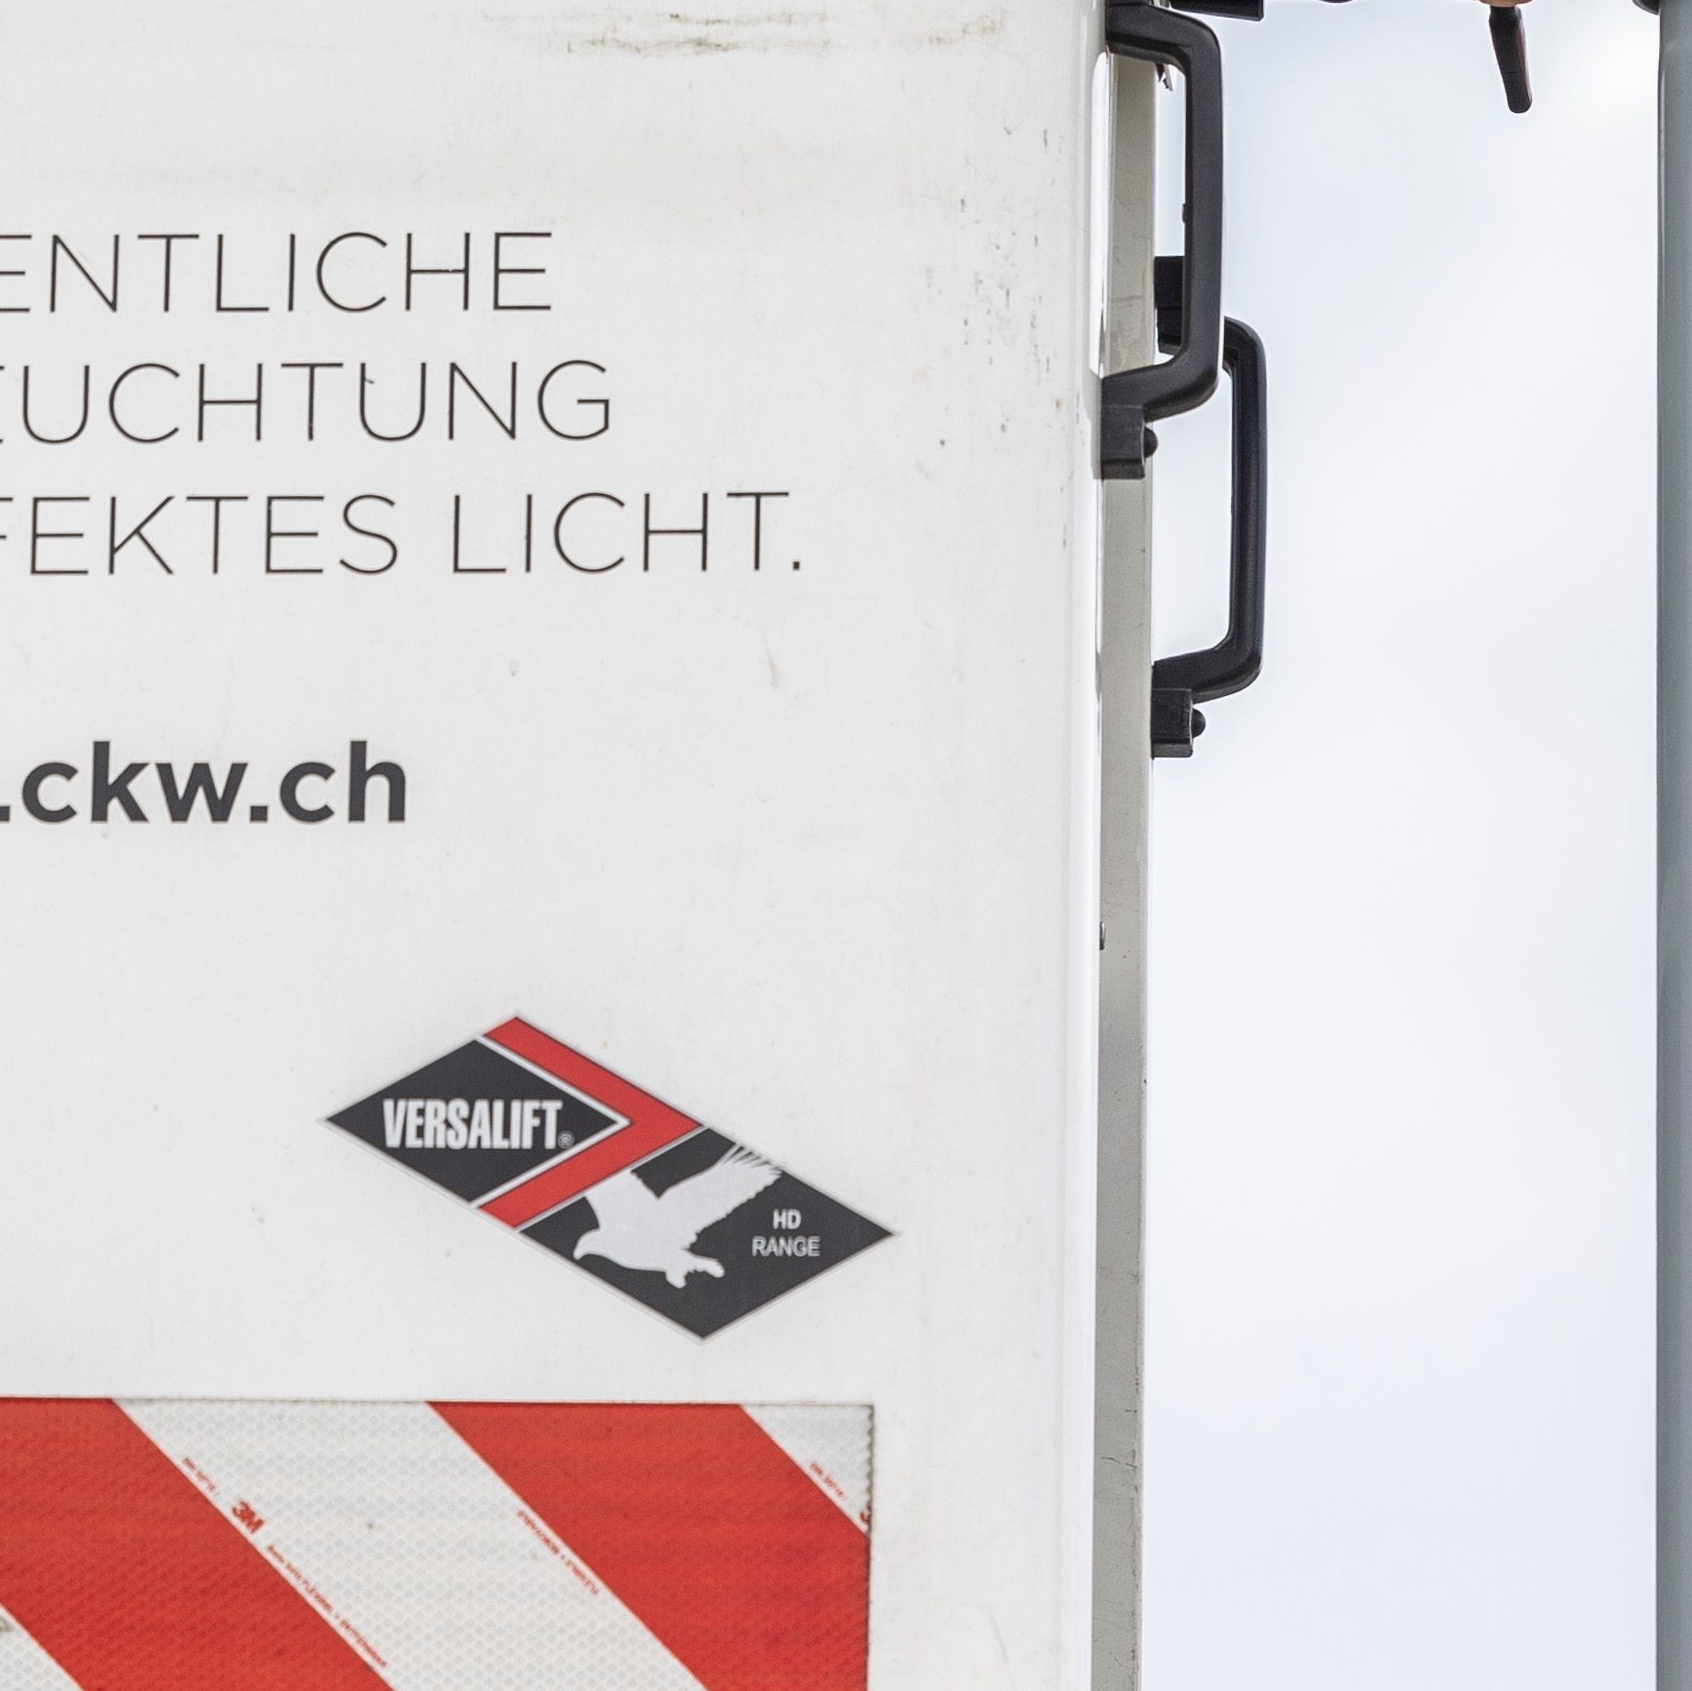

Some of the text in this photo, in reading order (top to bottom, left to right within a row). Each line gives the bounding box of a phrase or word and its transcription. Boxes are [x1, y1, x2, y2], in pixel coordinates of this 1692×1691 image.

[452, 491, 801, 574] LICHT.
[772, 1209, 802, 1230] HD
[752, 1236, 820, 1257] RANGE
[232, 1501, 264, 1534] 3M
